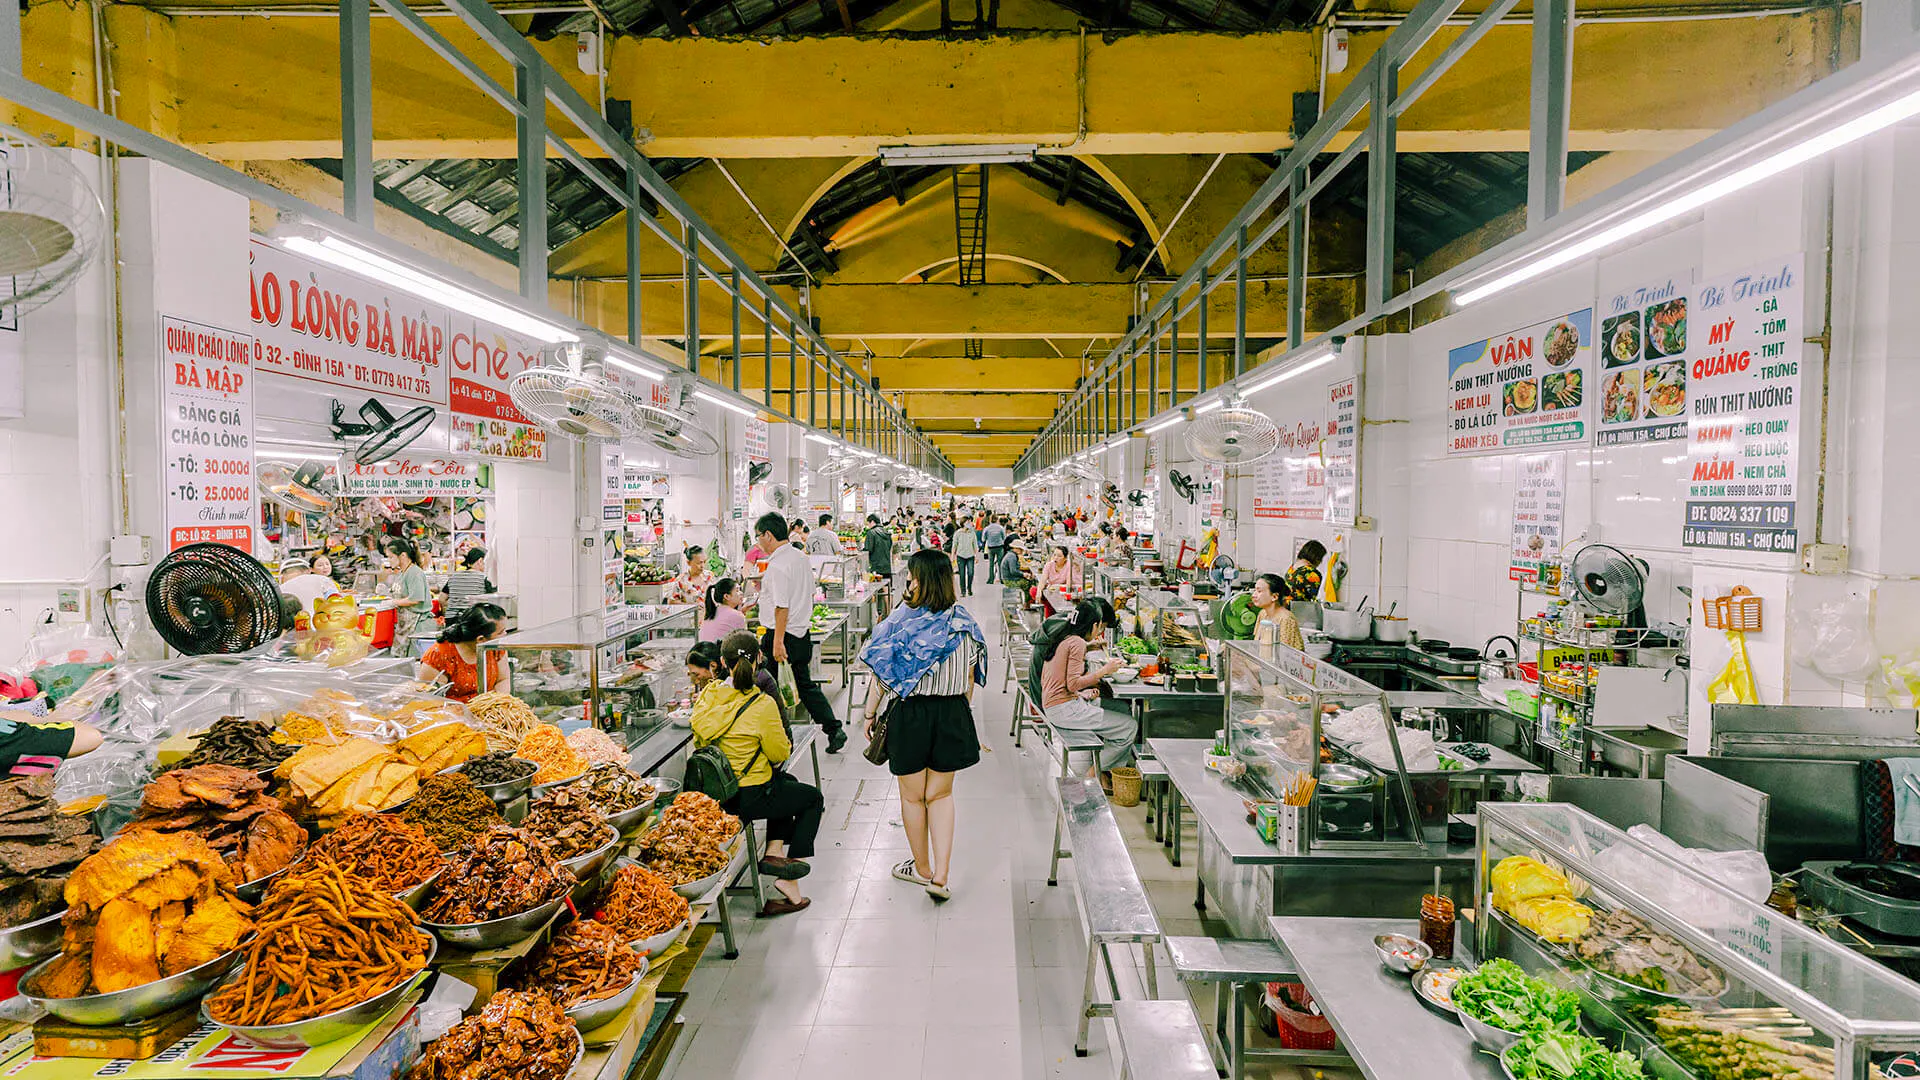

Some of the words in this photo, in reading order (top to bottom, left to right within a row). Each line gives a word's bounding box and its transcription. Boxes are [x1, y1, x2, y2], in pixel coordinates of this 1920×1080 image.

[1732, 264, 1795, 302] Trinh
[1633, 280, 1675, 306] Trinh
[1763, 296, 1778, 313] GÀ
[289, 271, 360, 347] LÒNG
[366, 296, 397, 357] BÀ
[401, 309, 444, 376] MẬP
[1762, 318, 1786, 335] TÔM
[168, 325, 195, 355] QUÁN
[197, 332, 223, 360] CHÁO
[225, 336, 249, 365] LÒNG
[1490, 336, 1534, 367] VÂN
[1762, 341, 1785, 358] THỊT
[266, 345, 281, 365] 32
[293, 349, 322, 373] ĐÌNH
[325, 358, 345, 378] 15A
[354, 366, 369, 382] ĐT:
[372, 369, 395, 388] 0779
[397, 374, 413, 392] 417
[415, 379, 431, 395] 375
[1693, 347, 1751, 381] QUẢNG
[1761, 361, 1797, 380] TRỨNG
[175, 359, 201, 388] BÀ
[206, 365, 243, 398] MẬP
[1455, 376, 1473, 391] BÚN
[1476, 372, 1494, 389] THỊT
[1497, 363, 1532, 383] NƯỚNG
[461, 385, 470, 398] 41
[484, 390, 497, 403] 15A
[1455, 397, 1474, 412] NEM
[1477, 394, 1491, 411] LỤI
[1695, 395, 1717, 416] BÚN
[1720, 391, 1745, 415] THỊT
[1748, 385, 1793, 410] NƯỚNG
[179, 402, 216, 424] BẢNG
[220, 408, 241, 426] GIÁ
[1481, 409, 1498, 426] LỐT
[172, 427, 210, 445] CHÁO
[214, 430, 249, 448] LÒNG
[452, 415, 475, 433] Kem
[490, 421, 507, 437] Chè
[527, 427, 546, 443] Sinh
[1636, 429, 1649, 441] 15A
[1745, 422, 1762, 436] HEO
[1766, 420, 1789, 435] QUAY
[1744, 444, 1763, 457] HEO
[1765, 442, 1789, 458] LUỘC
[178, 454, 198, 473] TÔ:
[428, 459, 466, 476] Cồn
[1692, 452, 1735, 481] MẮM
[1743, 465, 1764, 478] NEM
[1767, 460, 1786, 478] CHẢ
[178, 481, 198, 501] TÔ:
[405, 479, 422, 489] SINH
[607, 476, 619, 489] HEO
[1709, 486, 1725, 496] BANK
[1727, 485, 1746, 496] 99999
[1747, 485, 1763, 496] 0824
[1765, 484, 1777, 496] 337
[1779, 484, 1792, 496] 109
[1691, 505, 1708, 521] ĐT:
[1710, 506, 1737, 522] 0824
[1740, 506, 1762, 522] 337
[1766, 506, 1789, 523] 109
[175, 530, 189, 542] ĐC:
[190, 528, 200, 541] LÔ
[201, 529, 210, 541] 32
[216, 528, 234, 540] ĐÌNH
[235, 528, 248, 539] 15A
[1684, 528, 1695, 544] LÔ
[1696, 531, 1706, 544] 04
[1707, 528, 1728, 546] ĐÌNH
[1729, 533, 1746, 546] 15A
[1753, 533, 1773, 551] CHỢ
